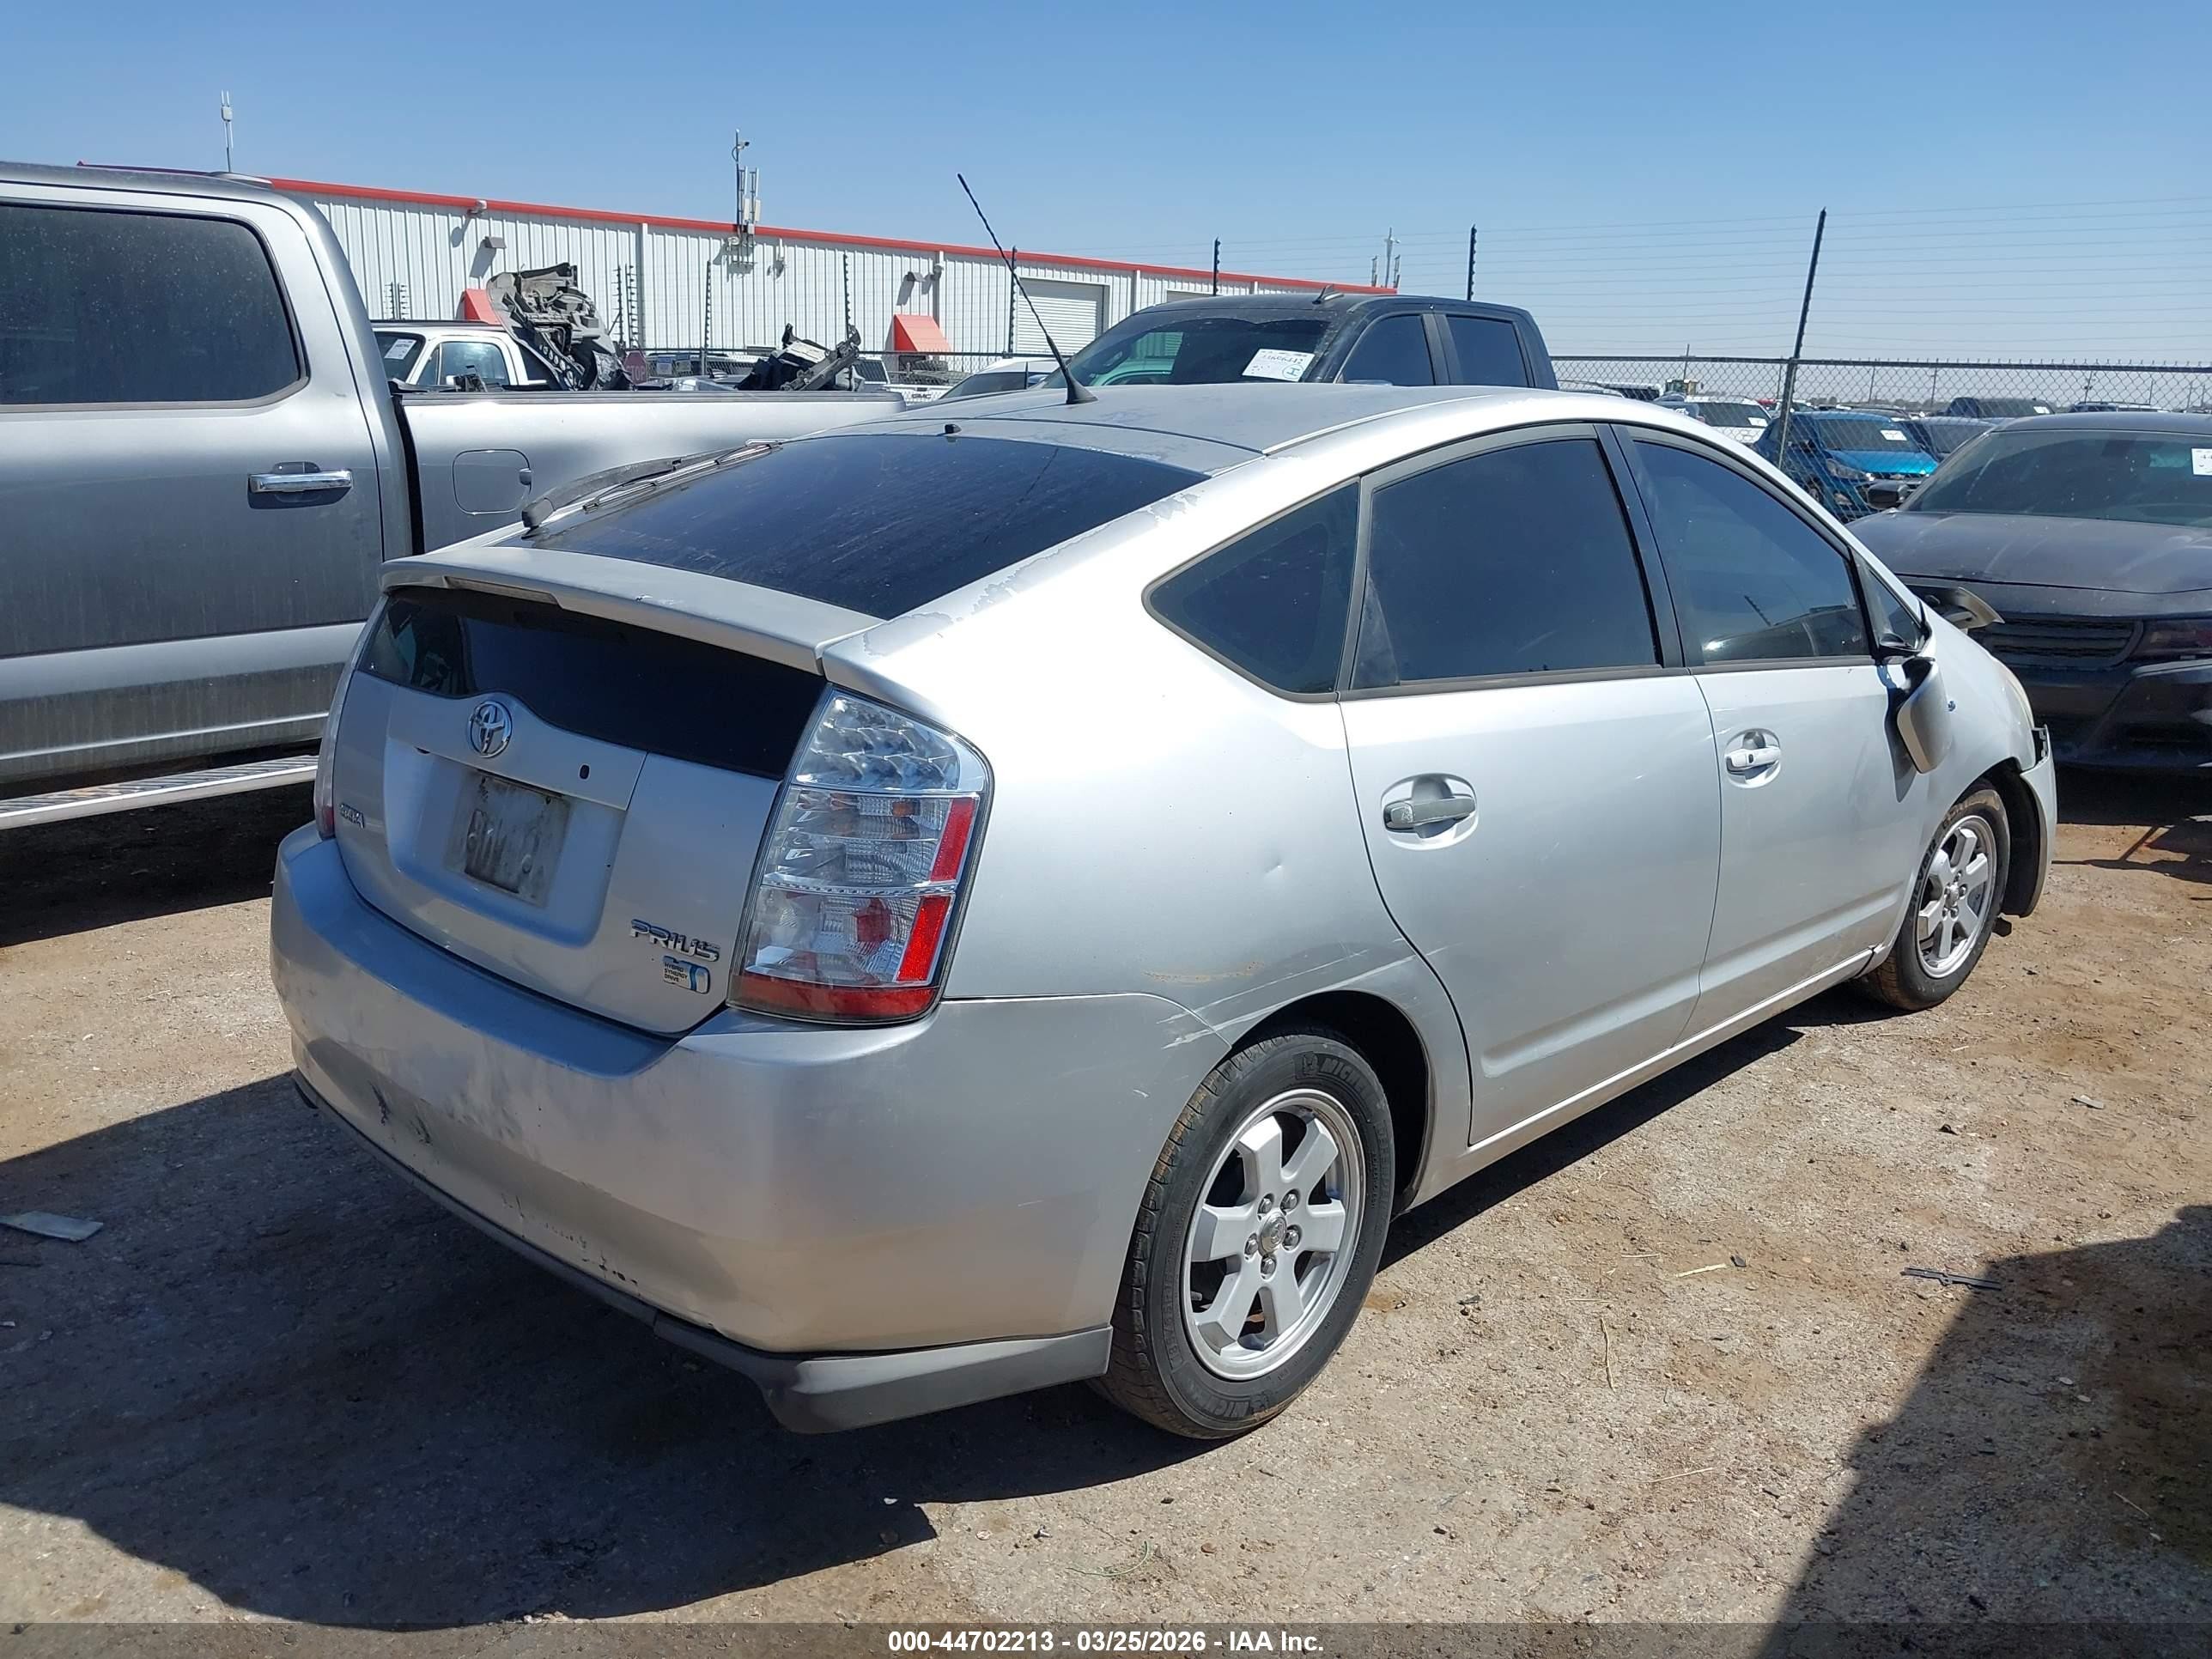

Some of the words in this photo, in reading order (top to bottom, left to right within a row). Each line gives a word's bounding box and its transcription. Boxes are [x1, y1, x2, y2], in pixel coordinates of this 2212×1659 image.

[626, 365, 646, 380] STOP
[630, 919, 720, 962] PRIUS
[664, 963, 684, 972] HYBRID
[664, 968, 688, 979] SYNERGY
[664, 974, 679, 982] DRIVE
